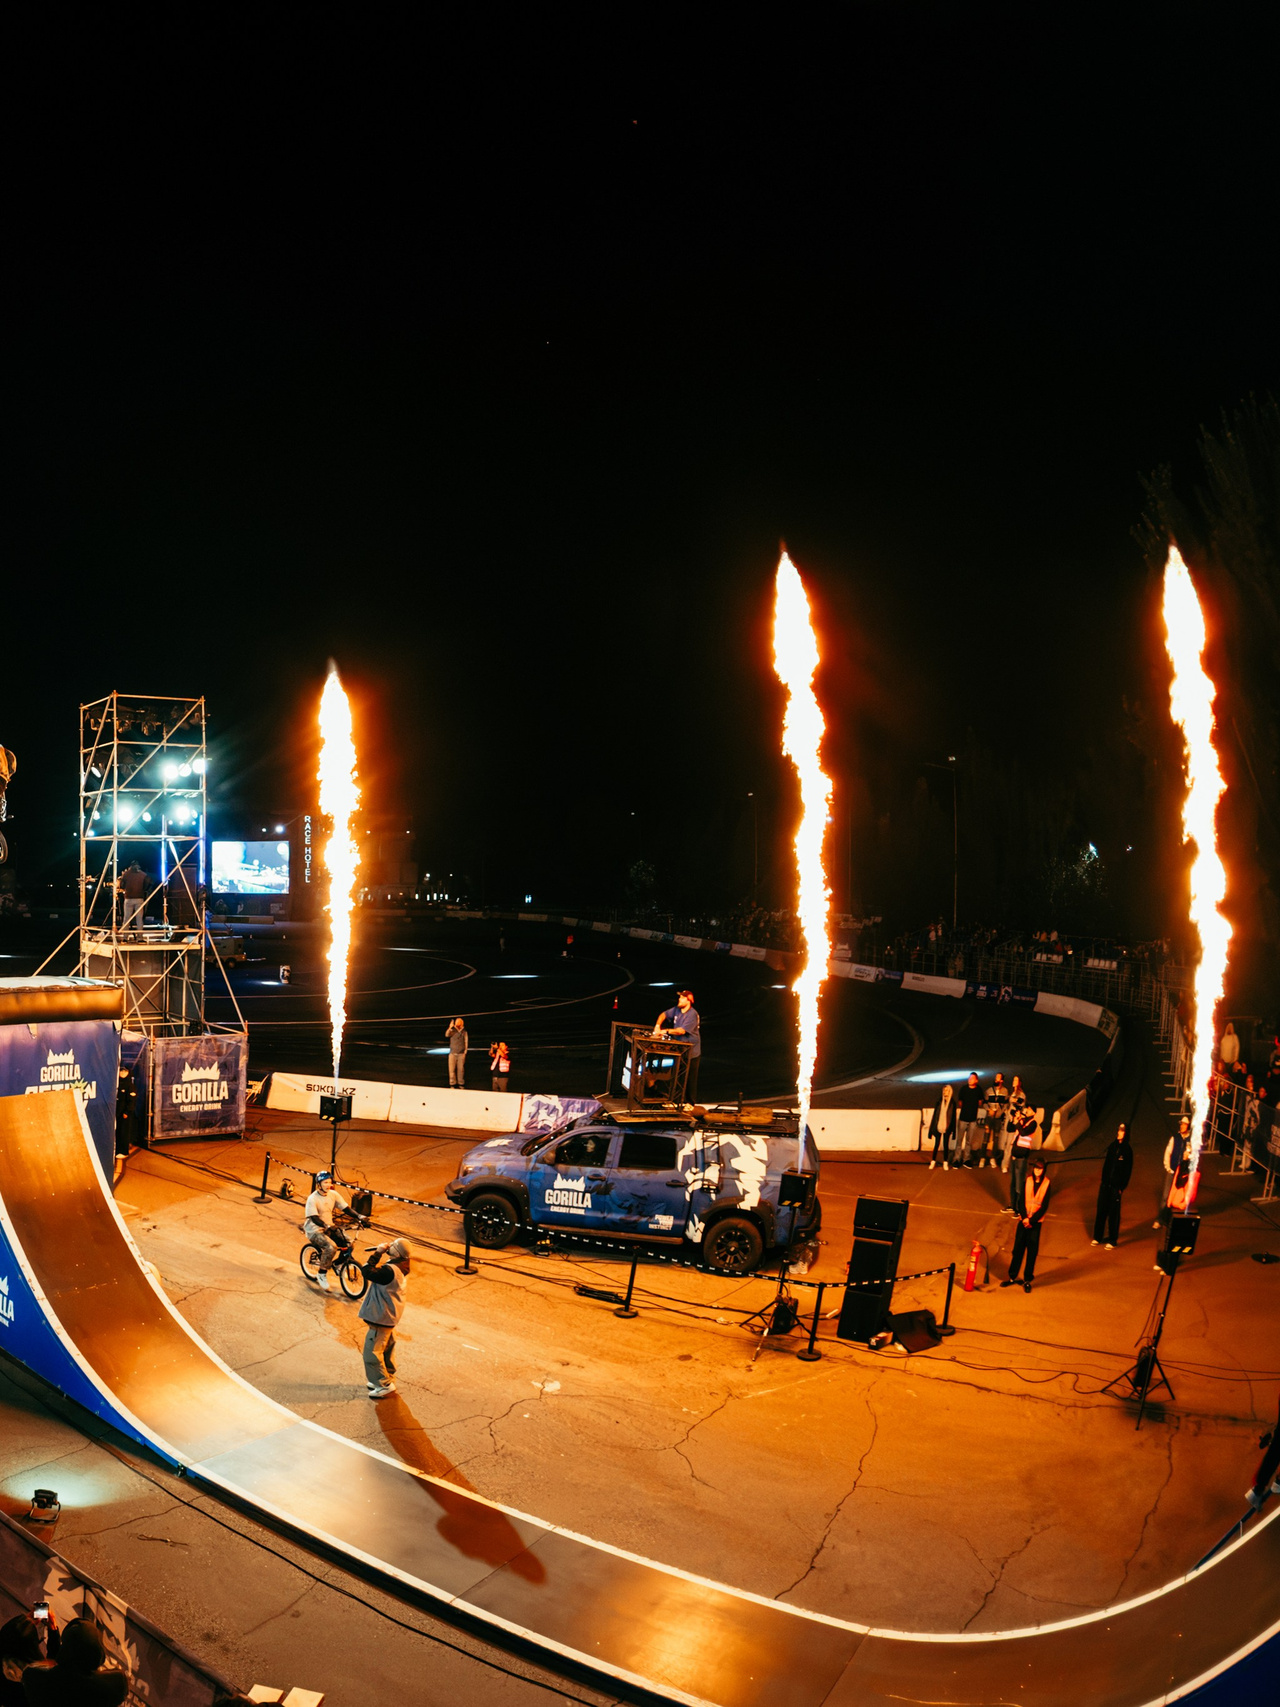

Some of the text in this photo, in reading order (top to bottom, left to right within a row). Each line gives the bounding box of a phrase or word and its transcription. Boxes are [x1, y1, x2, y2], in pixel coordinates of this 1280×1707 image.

[304, 815, 312, 883] RACE HOTEL
[40, 1064, 81, 1083] GORILLA
[172, 1080, 229, 1104] GORILLA
[544, 1188, 592, 1209] GORILLA
